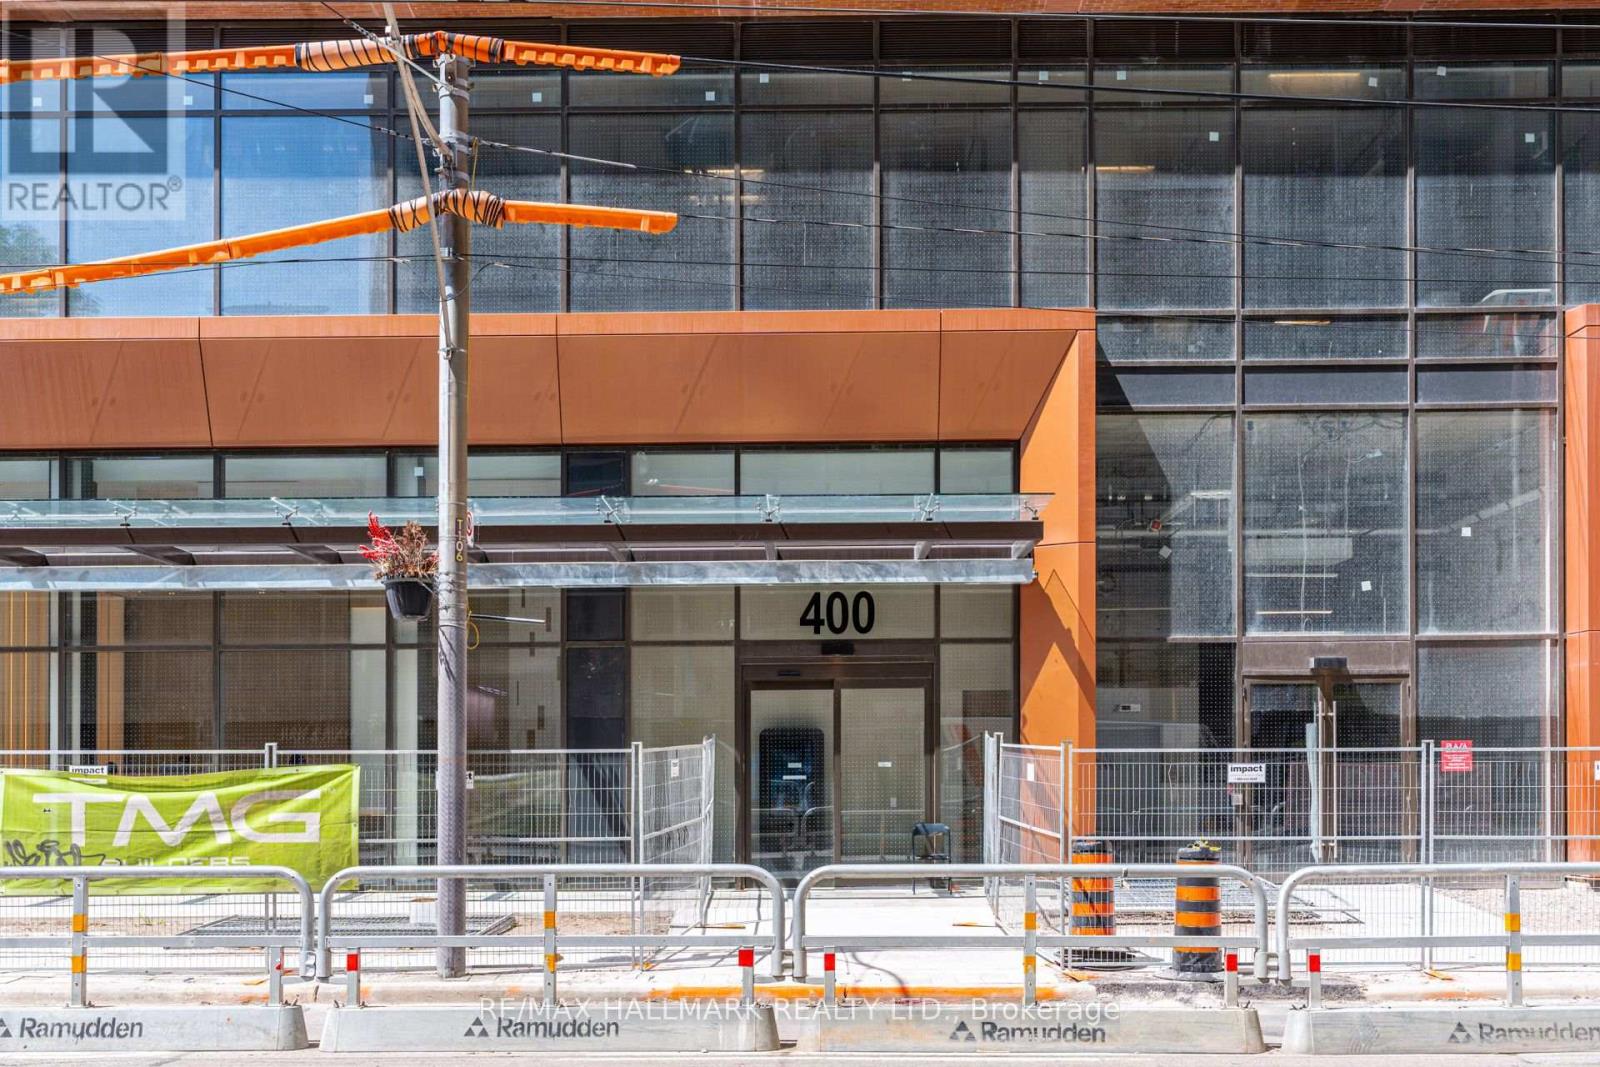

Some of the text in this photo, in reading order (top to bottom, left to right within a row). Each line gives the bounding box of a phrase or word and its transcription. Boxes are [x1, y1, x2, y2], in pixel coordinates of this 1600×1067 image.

[800, 591, 875, 635] 400
[1230, 765, 1263, 773] impact
[33, 789, 321, 847] TMG
[497, 1017, 619, 1038] Ramudden
[981, 1021, 1106, 1042] Ramudden
